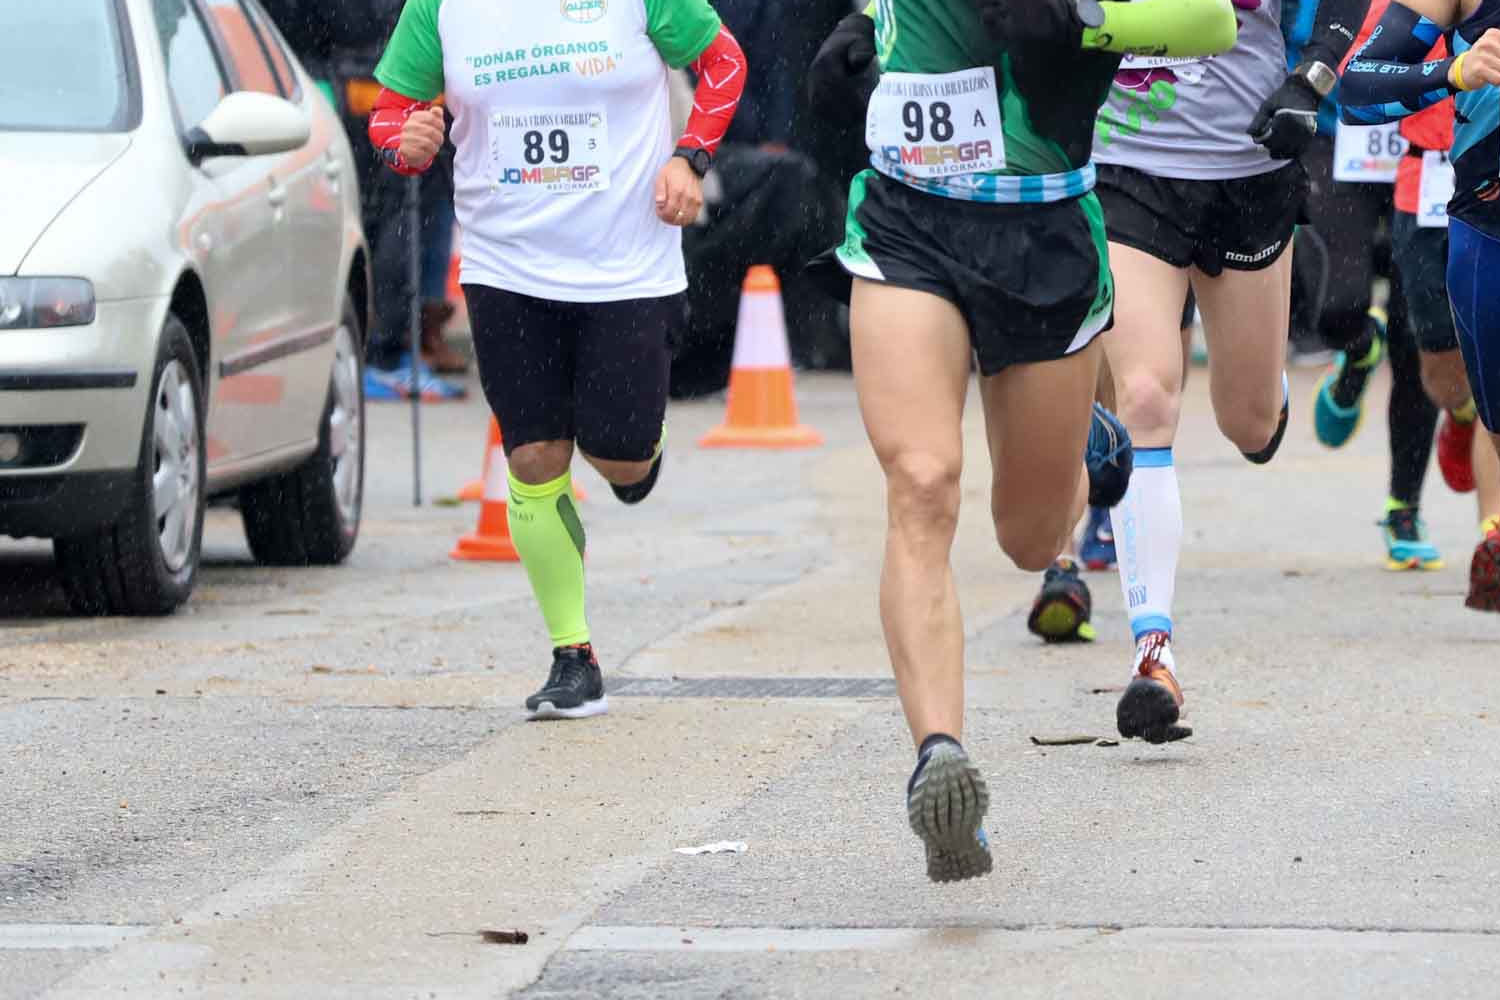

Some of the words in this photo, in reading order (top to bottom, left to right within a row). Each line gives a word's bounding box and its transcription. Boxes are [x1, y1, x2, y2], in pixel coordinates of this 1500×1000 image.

[474, 73, 492, 86] ES
[496, 61, 570, 82] REGALAR
[902, 101, 954, 142] 98
[973, 109, 986, 127] A
[523, 129, 569, 165] 89
[1368, 130, 1401, 156] 86
